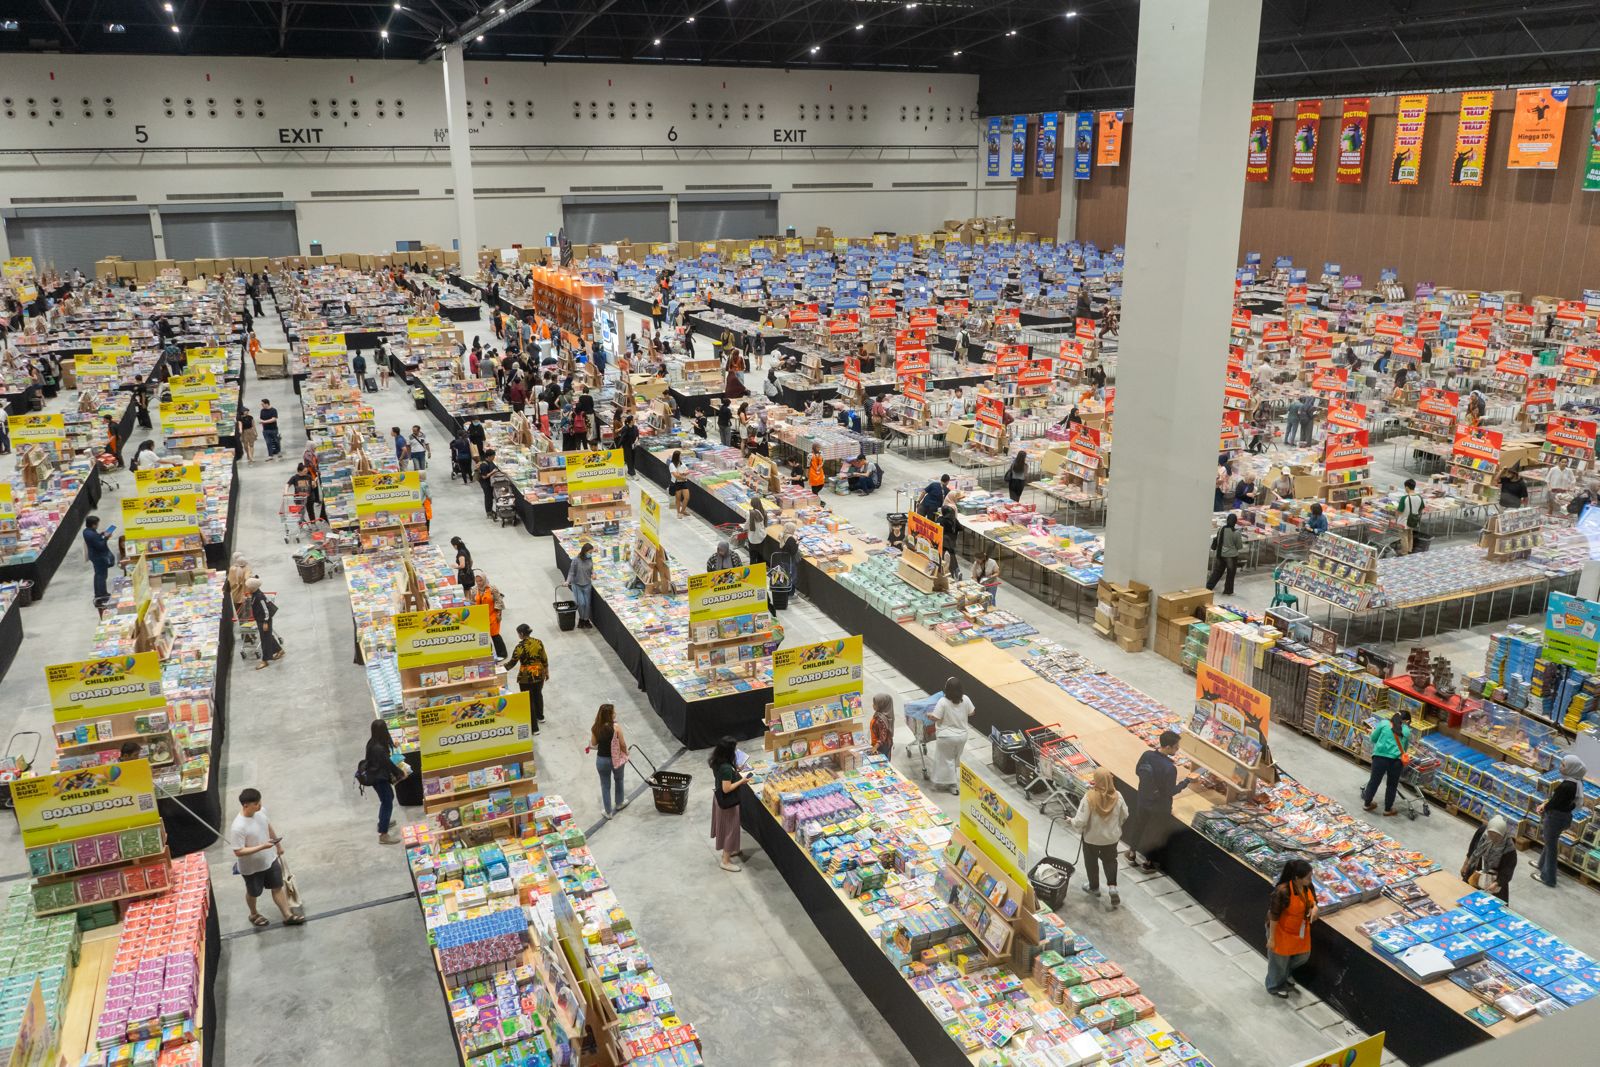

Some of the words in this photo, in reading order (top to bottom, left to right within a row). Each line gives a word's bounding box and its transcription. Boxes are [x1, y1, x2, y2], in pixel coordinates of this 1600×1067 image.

[136, 126, 148, 144] 5
[279, 129, 323, 144] EXIT
[668, 126, 678, 142] 6
[774, 130, 806, 142] EXIT
[1334, 413, 1358, 423] ROMANCE
[1554, 432, 1587, 442] LITERATURE
[1075, 439, 1095, 450] ROMANCE
[1462, 441, 1493, 453] LITERATURE
[1333, 448, 1362, 457] LITERATURE
[366, 492, 390, 500] BOARD
[136, 517, 163, 525] BOARD
[702, 595, 730, 606] BOARD
[732, 590, 754, 600] BOOK
[413, 638, 446, 647] BOARD
[448, 634, 475, 643] BOOK
[803, 660, 834, 669] CHILDREN
[85, 676, 124, 685] CHILDREN
[789, 672, 821, 685] BOARD
[823, 667, 848, 678] BOOK
[70, 688, 110, 701] BOARD
[112, 683, 144, 695] BOOK
[1213, 682, 1251, 712] DEALS
[456, 718, 495, 728] CHILDREN
[440, 732, 480, 746] BOARD
[481, 726, 513, 738] BOOK
[61, 788, 108, 801] CHILDREN
[42, 804, 92, 820] BOARD
[94, 796, 134, 811] BOOK
[981, 803, 1005, 828] CHILDREN
[971, 805, 995, 835] BOARD
[996, 828, 1016, 856] BOOK
